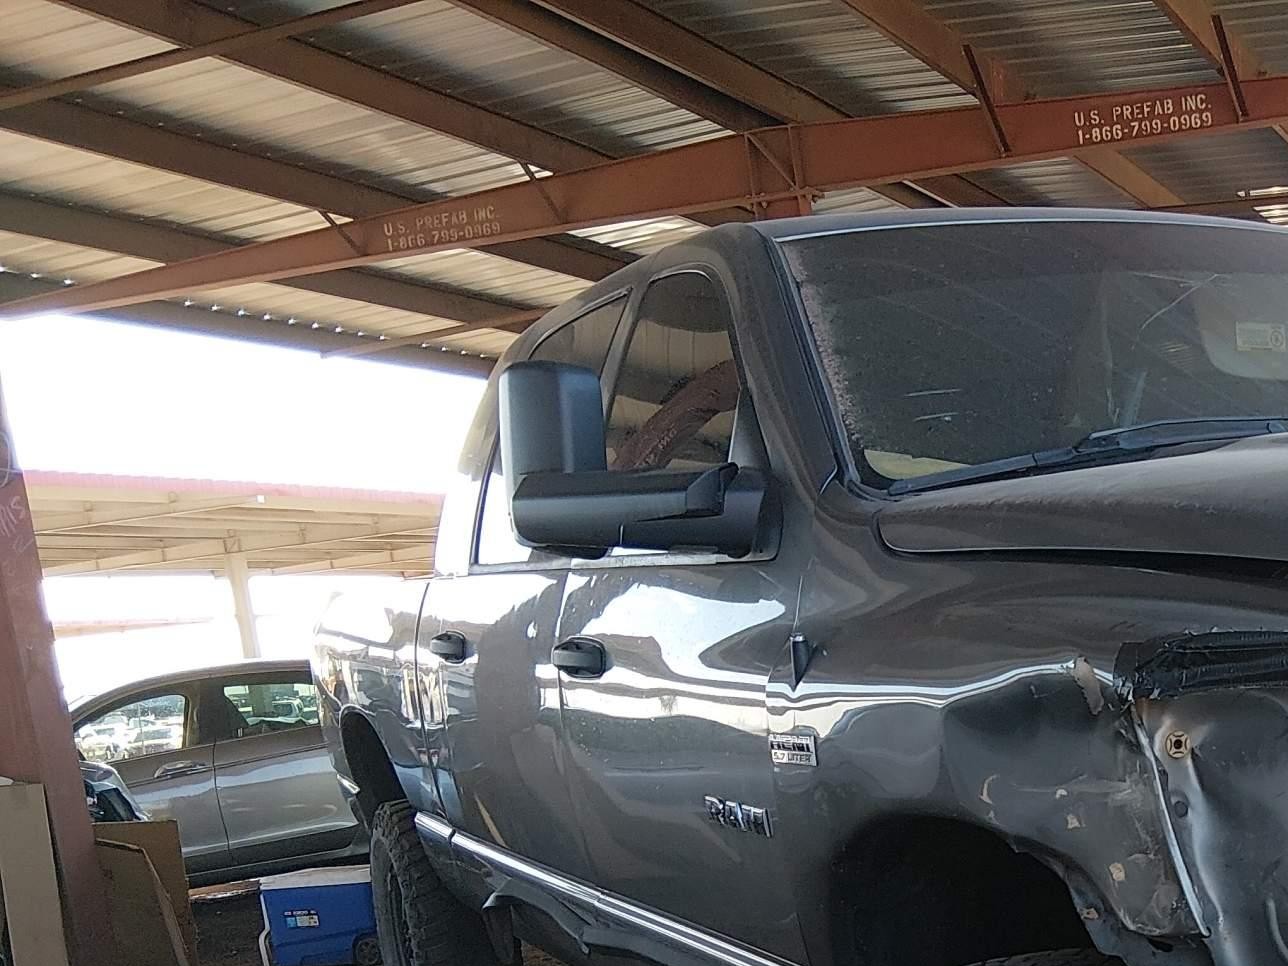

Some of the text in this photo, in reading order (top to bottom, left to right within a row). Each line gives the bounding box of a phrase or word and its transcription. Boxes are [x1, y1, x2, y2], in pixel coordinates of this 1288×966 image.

[1074, 94, 1212, 126] U.S. PREFAB INC.
[1077, 111, 1213, 145] 1-866-799-0969
[415, 210, 468, 231] PREFAB
[787, 752, 812, 763] LITER
